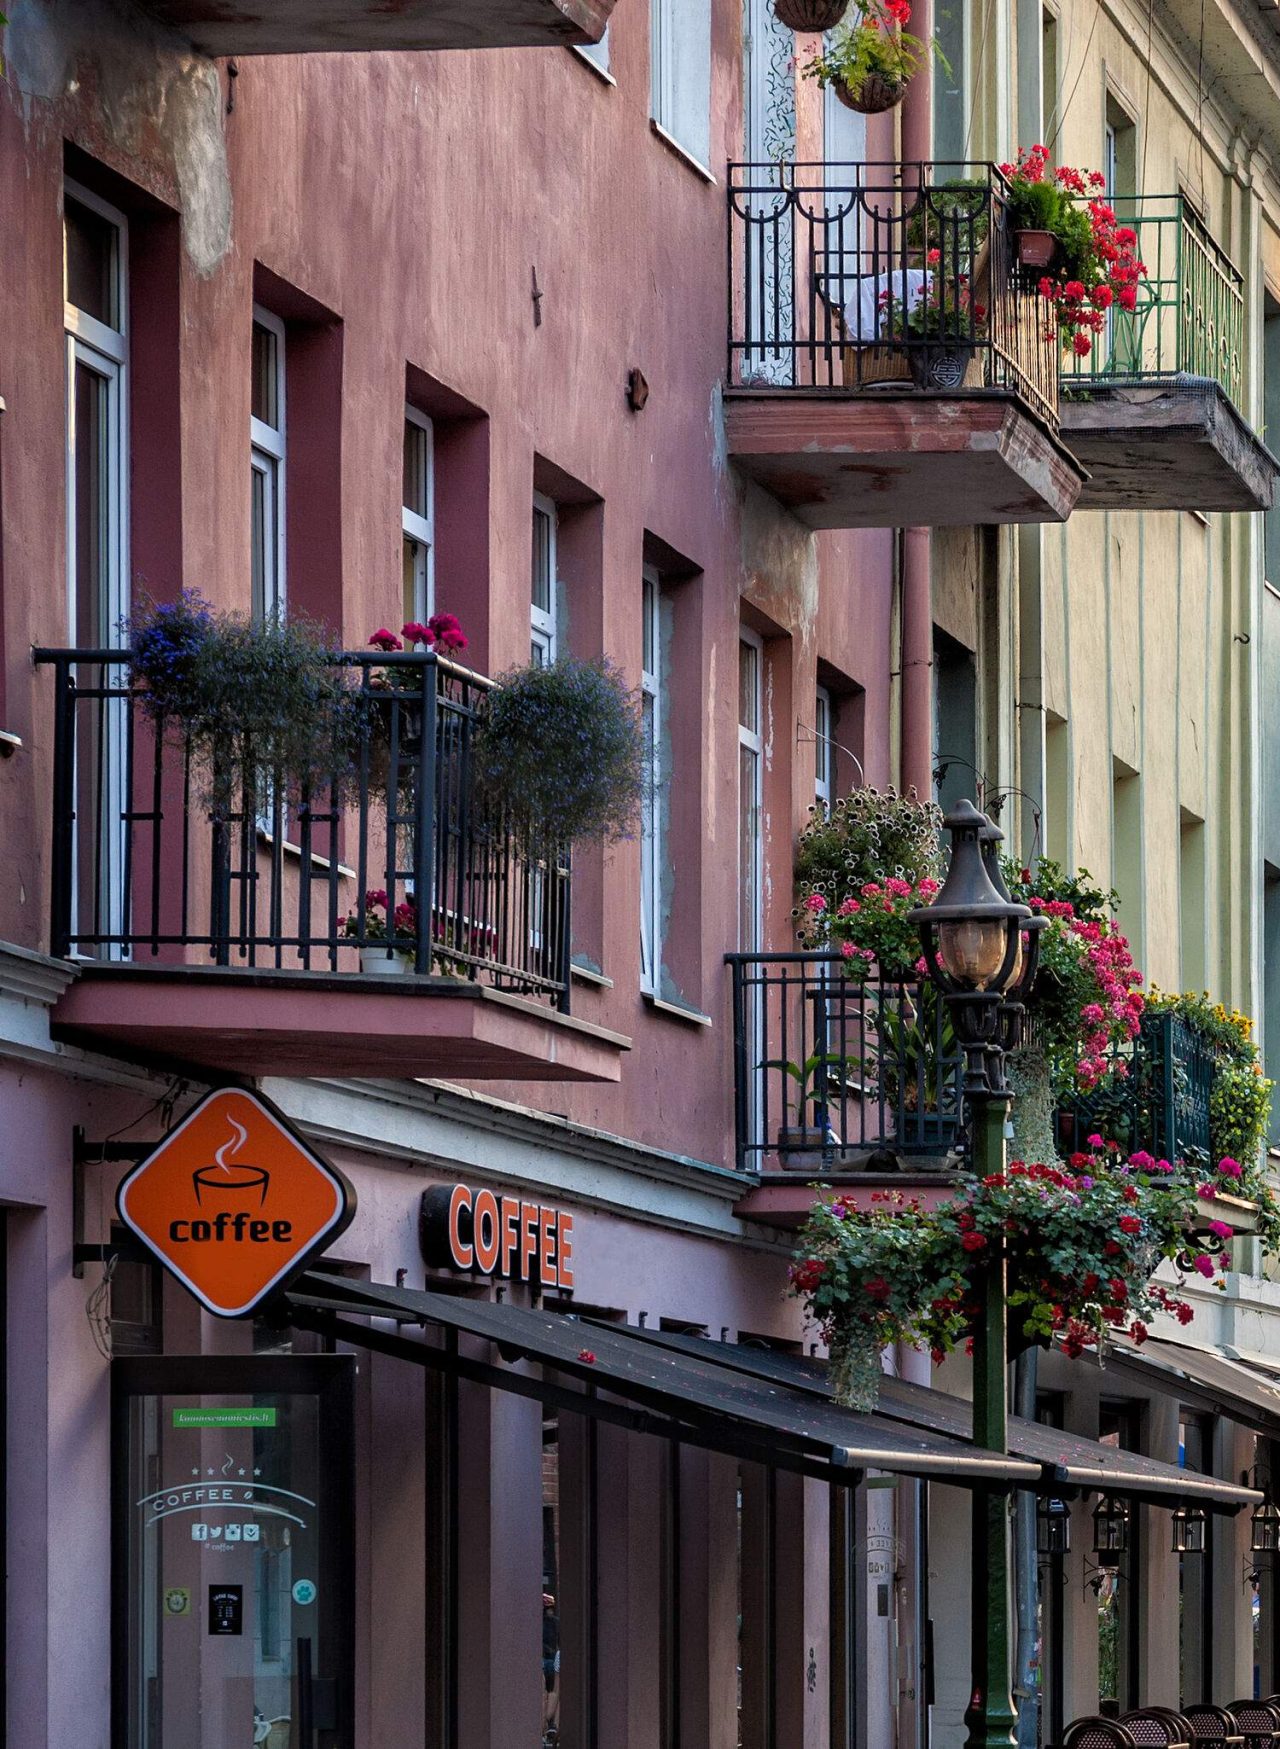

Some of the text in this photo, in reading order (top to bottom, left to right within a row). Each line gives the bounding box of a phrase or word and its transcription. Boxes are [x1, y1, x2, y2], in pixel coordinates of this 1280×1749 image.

[169, 1212, 293, 1242] coffee
[449, 1183, 574, 1290] COFFEE
[153, 1489, 233, 1511] COFFEE
